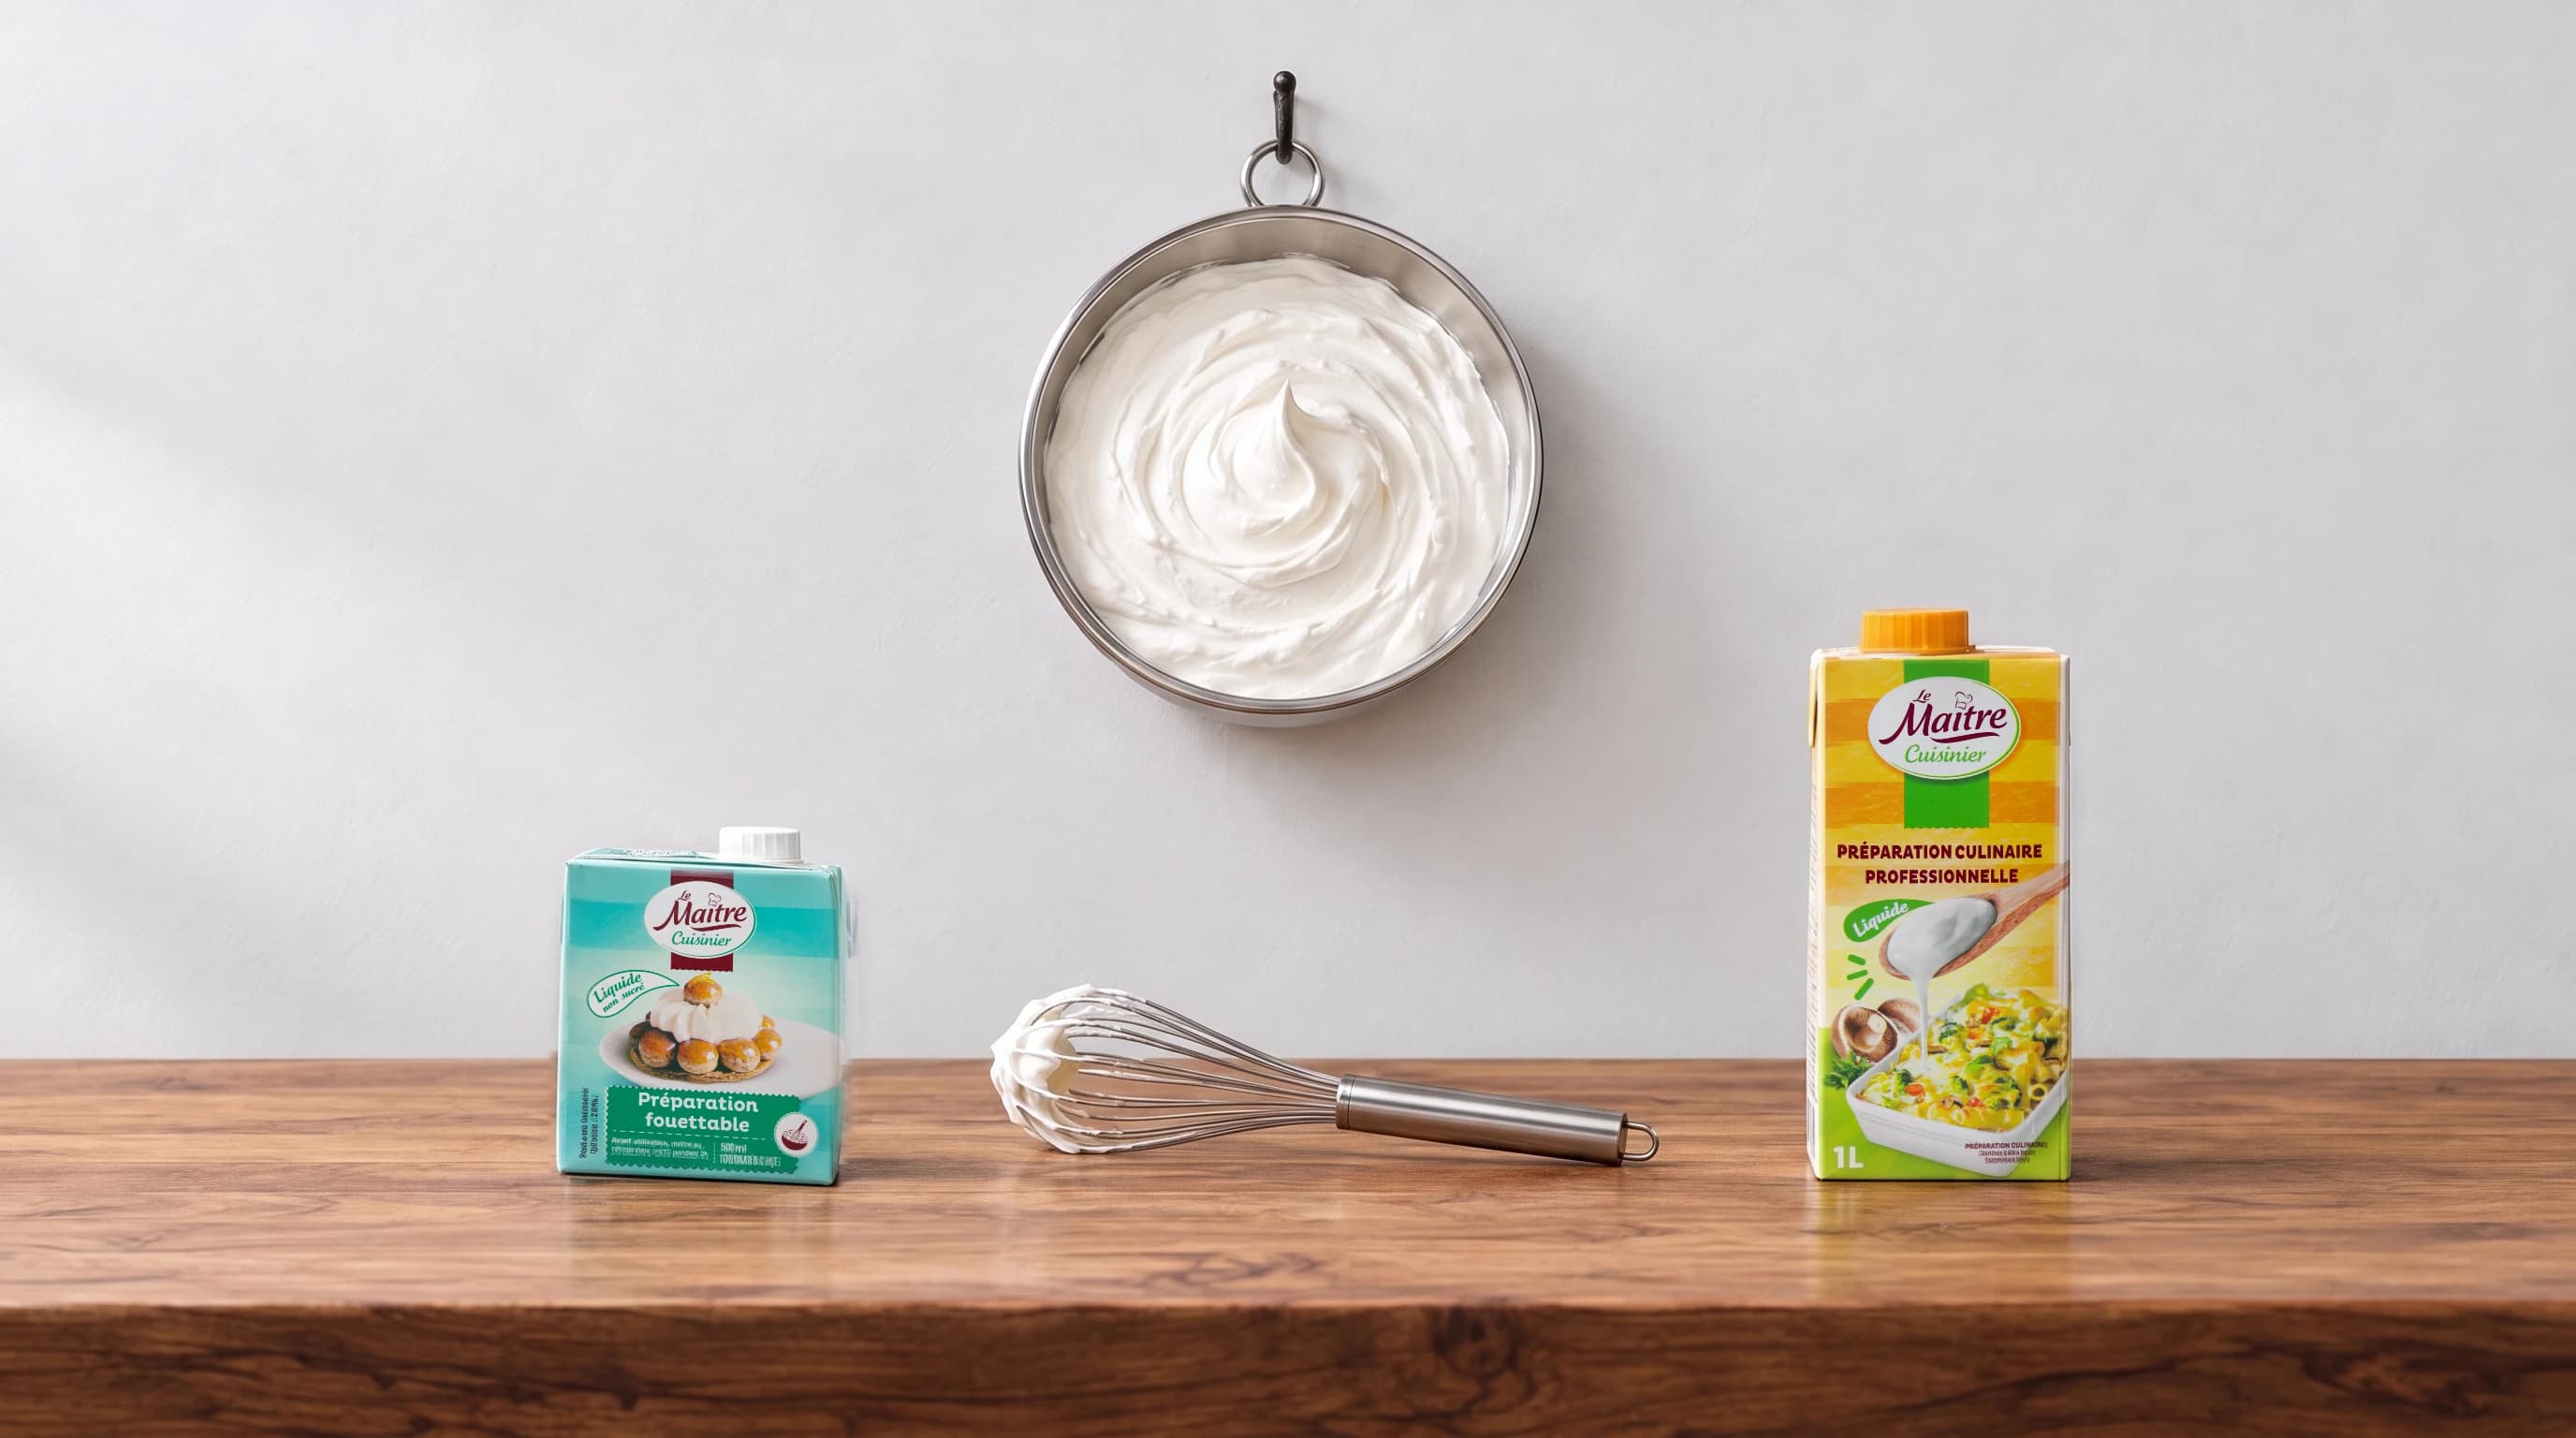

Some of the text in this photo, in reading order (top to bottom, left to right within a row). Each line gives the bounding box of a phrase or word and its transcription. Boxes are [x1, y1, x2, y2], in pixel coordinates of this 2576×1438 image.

[1912, 689, 1931, 703] Le
[1905, 744, 1986, 763] Cuisinier
[1837, 841, 2042, 859] PRÉPARATION CULINAIRE
[1866, 869, 2018, 884] PROFESSIONNELLE
[678, 890, 691, 901] Le
[1853, 902, 1909, 937] Liquide
[672, 932, 731, 946] Cuisinier
[593, 974, 641, 1003] Liquide
[603, 982, 644, 1012] non sucré
[638, 1093, 758, 1112] Préparation
[646, 1112, 750, 1132] fouettable
[1965, 1140, 2010, 1150] PRÉPARATION
[1833, 1146, 1864, 1169] 1L
